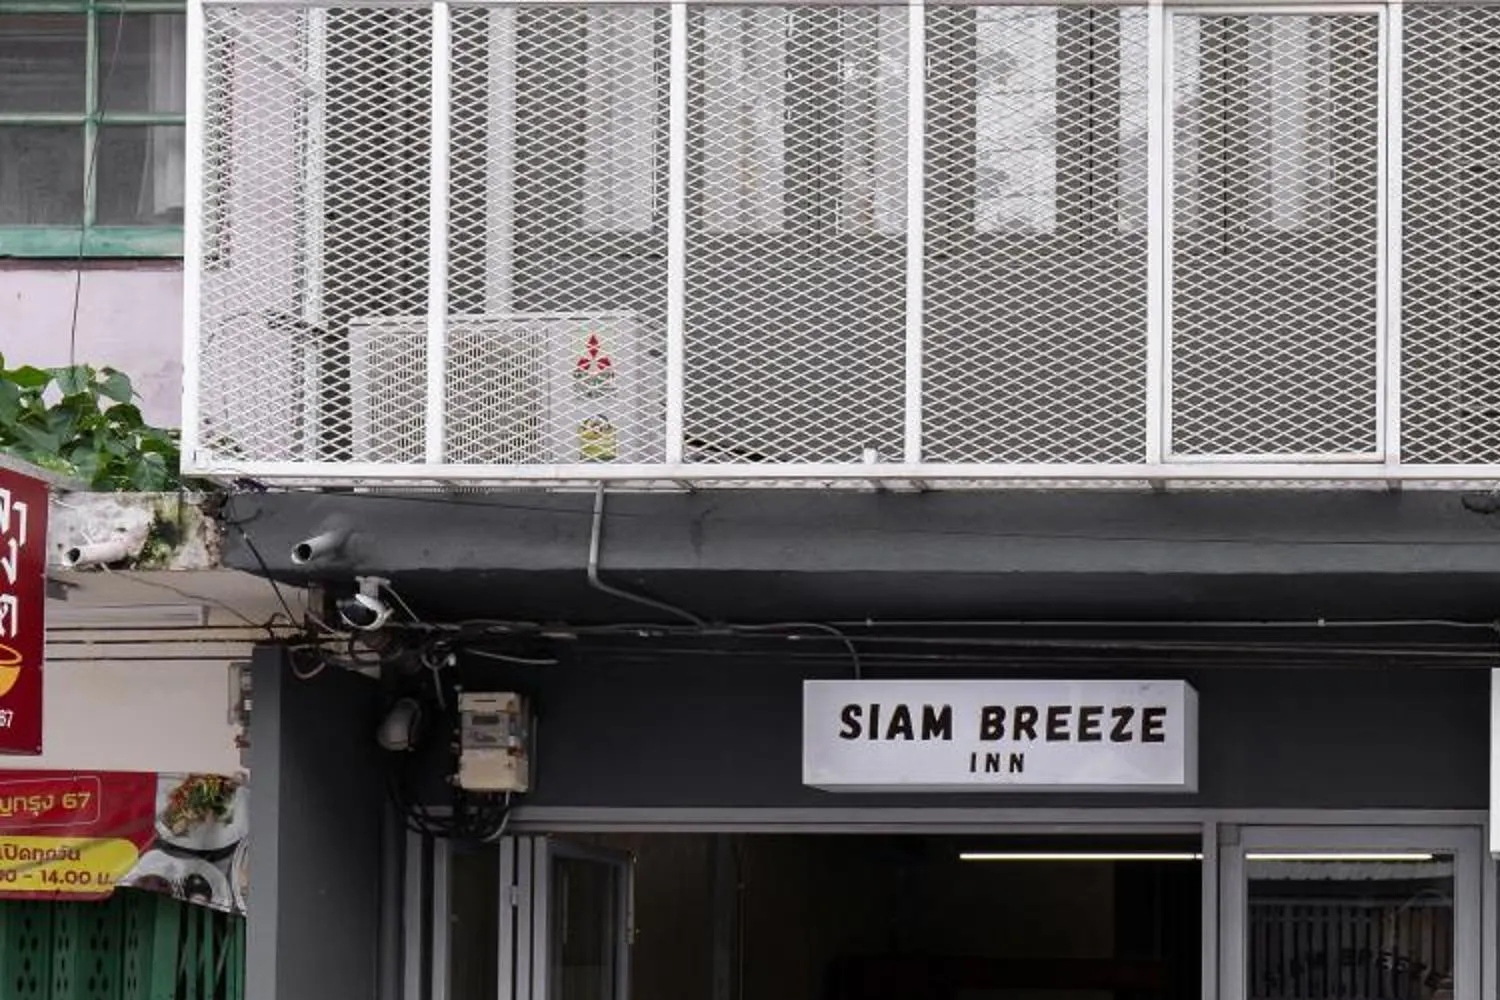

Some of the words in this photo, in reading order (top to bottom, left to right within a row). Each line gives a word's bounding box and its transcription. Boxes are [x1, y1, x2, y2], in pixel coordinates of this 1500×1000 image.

[839, 704, 953, 740] SIAM
[980, 705, 1167, 742] BREEZE
[969, 752, 1025, 773] INN
[62, 791, 91, 810] 67
[41, 869, 92, 885] 14.00
